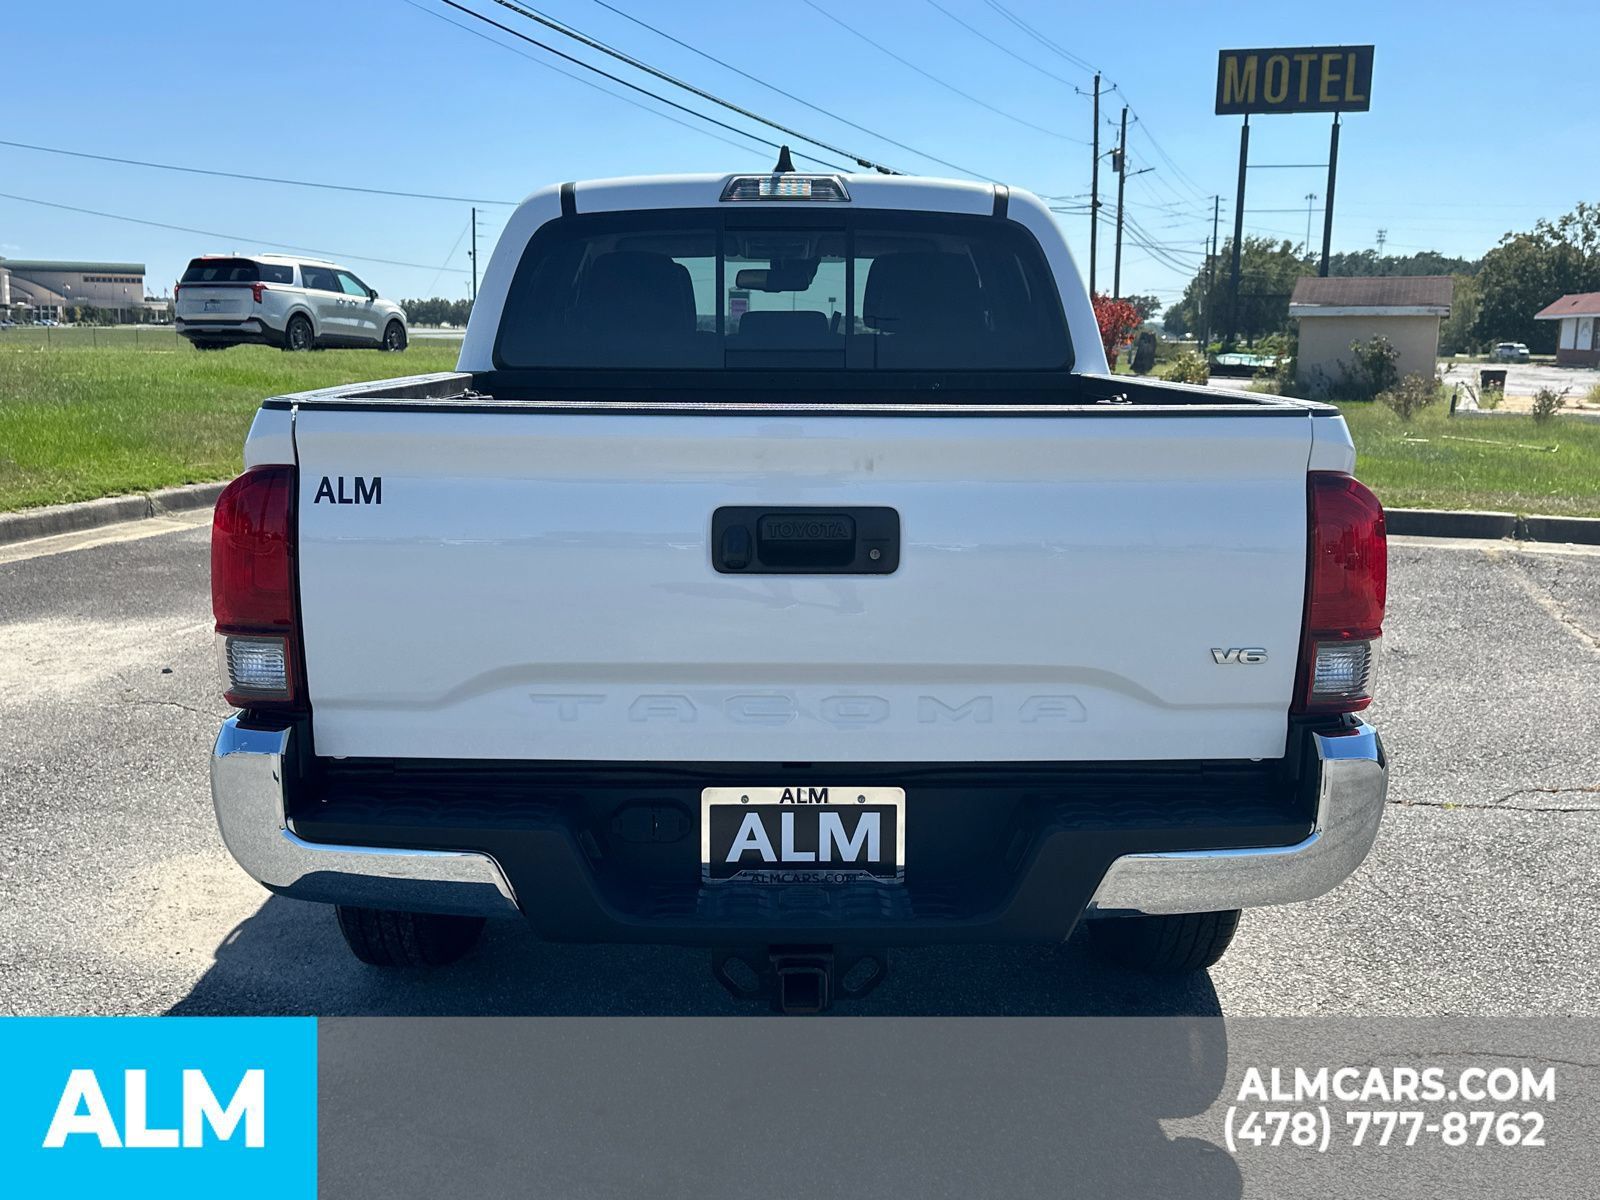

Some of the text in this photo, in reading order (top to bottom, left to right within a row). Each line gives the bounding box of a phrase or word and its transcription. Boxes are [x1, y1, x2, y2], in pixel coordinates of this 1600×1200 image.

[1223, 53, 1366, 105] MOTEL
[313, 476, 382, 505] ALM
[767, 521, 848, 538] TOYOTA
[1210, 647, 1268, 665] V6
[528, 693, 1089, 723] TACOMA
[779, 788, 829, 804] ALM
[725, 812, 881, 862] ALM
